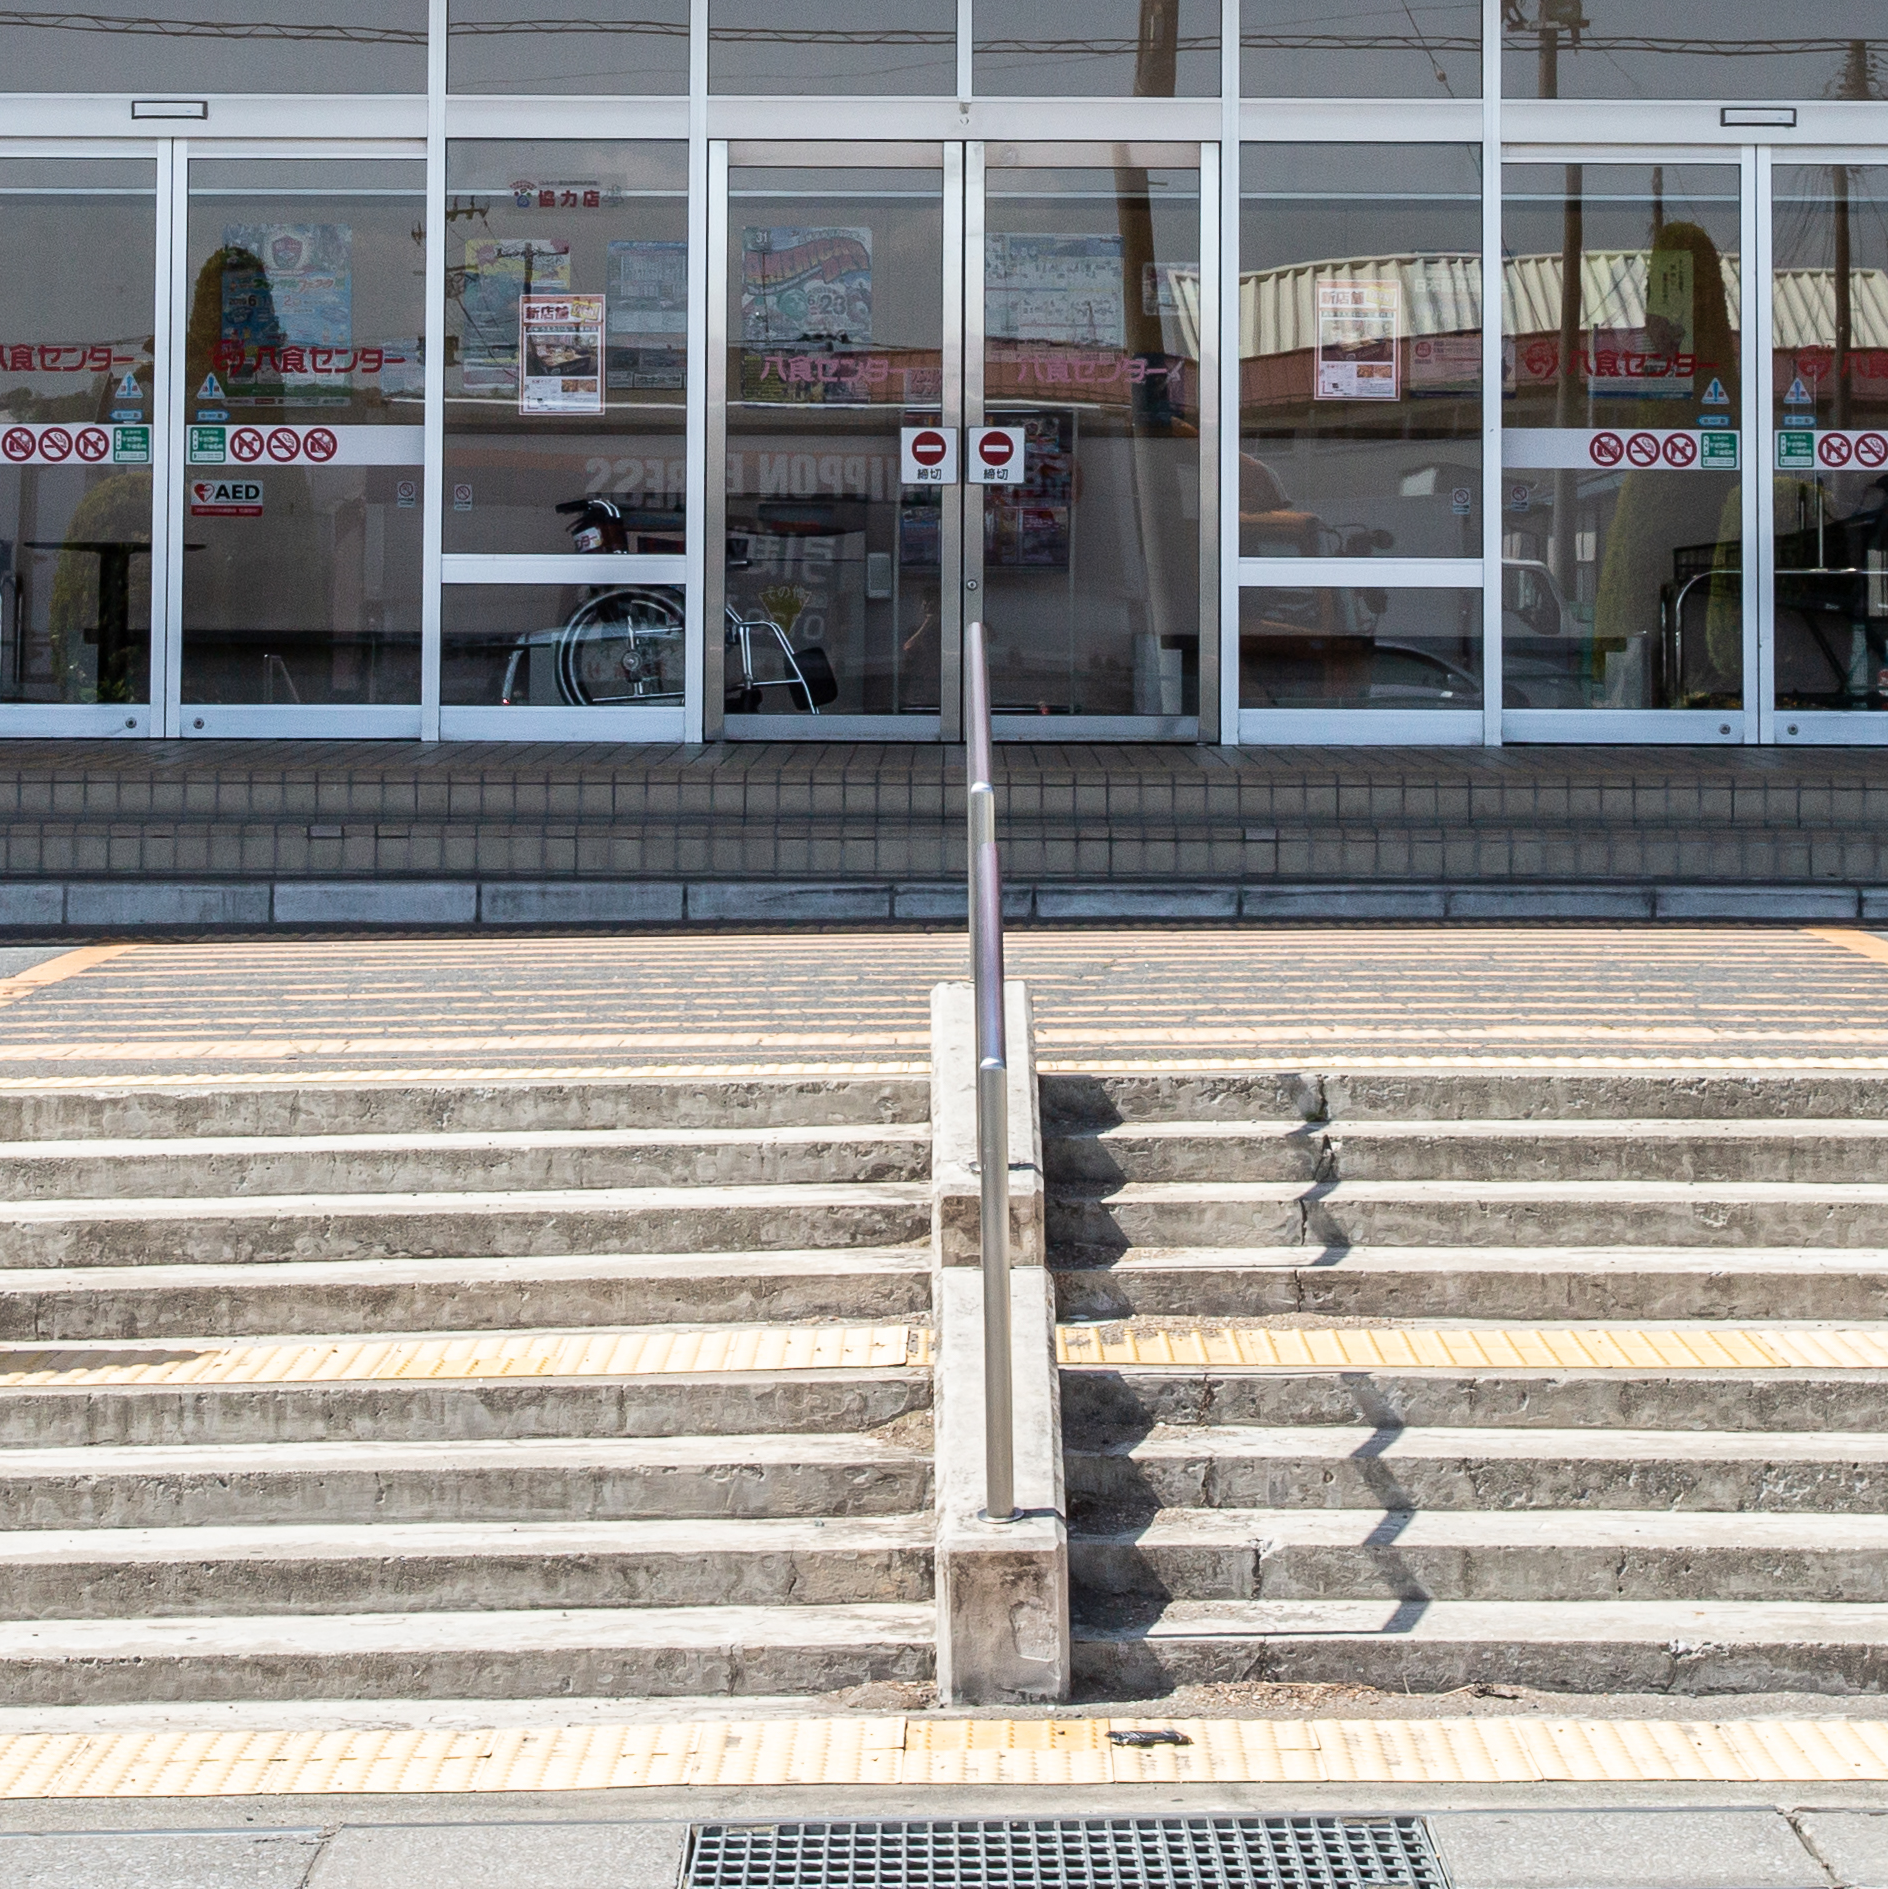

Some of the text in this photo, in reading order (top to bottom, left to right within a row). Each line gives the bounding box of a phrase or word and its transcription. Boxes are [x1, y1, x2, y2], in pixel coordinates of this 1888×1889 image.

[538, 190, 600, 208] 協力店
[252, 346, 408, 374] 八食センター
[760, 355, 907, 383] 八食センター
[1017, 356, 1168, 384] 八食センター
[1566, 348, 1720, 378] 八食センター
[917, 467, 942, 480] 締切
[983, 467, 1009, 480] 締切
[215, 484, 260, 500] AED
